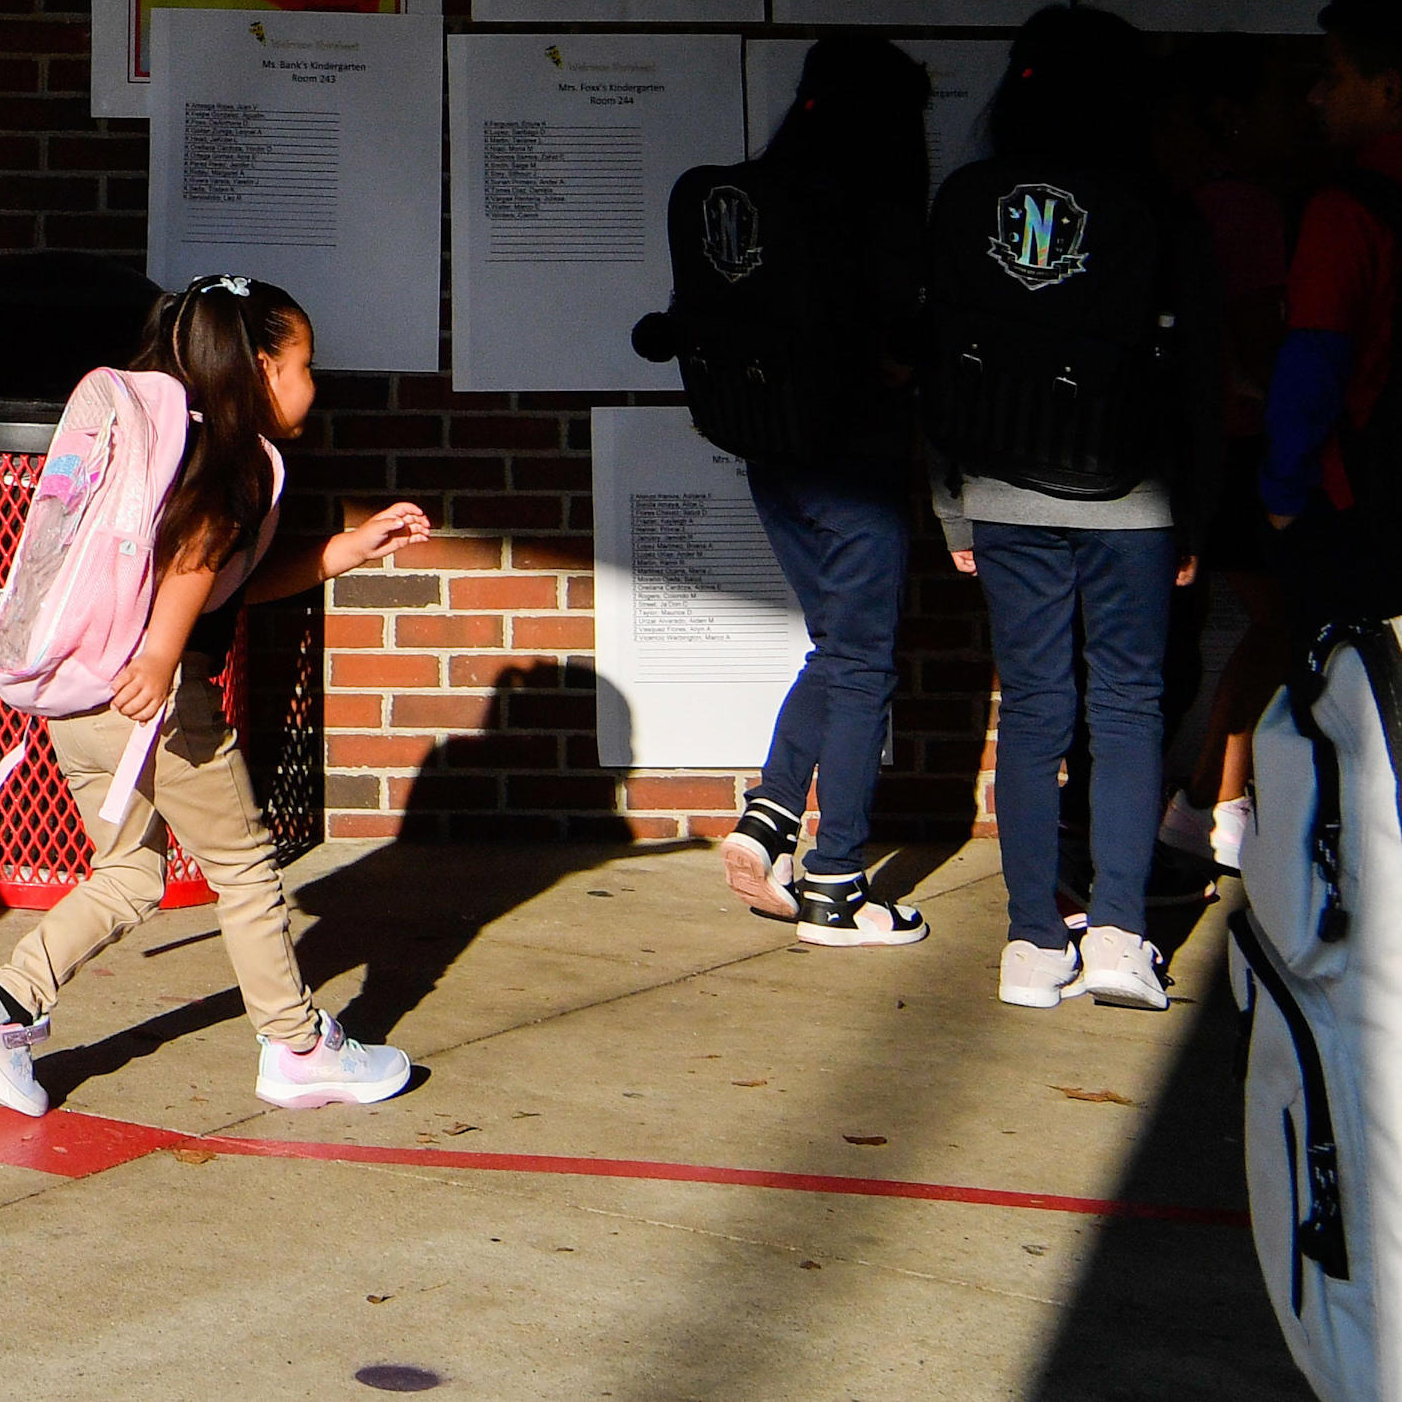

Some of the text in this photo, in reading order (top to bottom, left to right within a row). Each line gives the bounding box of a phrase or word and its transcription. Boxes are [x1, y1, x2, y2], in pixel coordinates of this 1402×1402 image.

[310, 61, 366, 72] Kindergarten
[291, 74, 317, 82] Room
[609, 84, 665, 94] Kindergarten
[590, 96, 616, 104] Room
[1018, 194, 1060, 267] N
